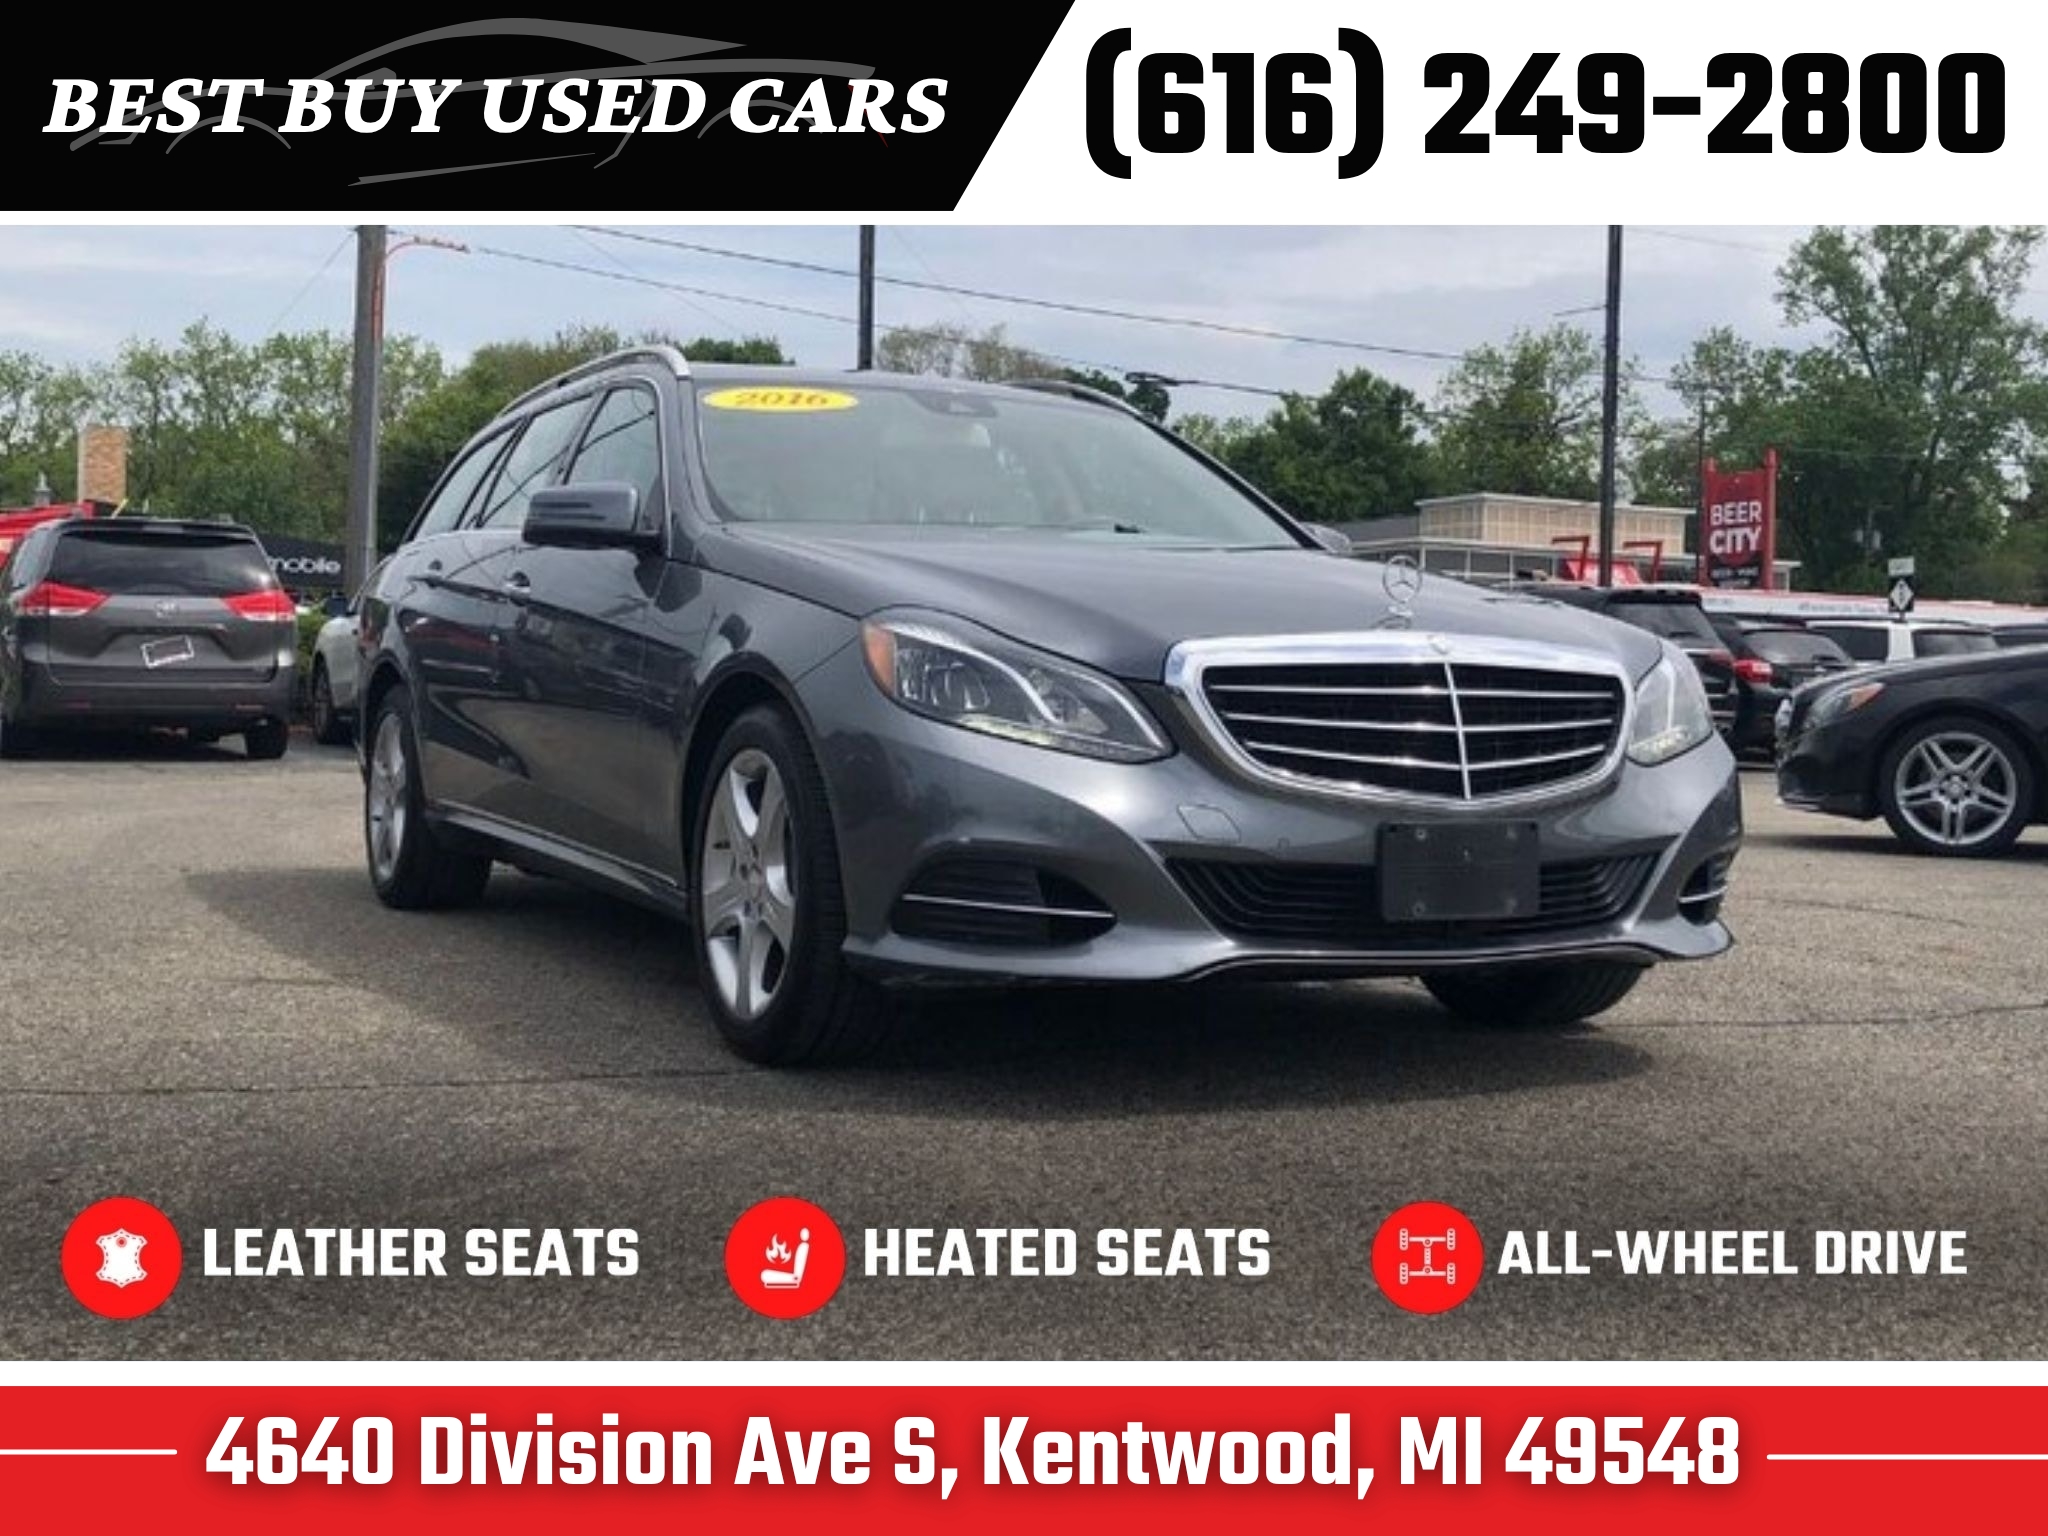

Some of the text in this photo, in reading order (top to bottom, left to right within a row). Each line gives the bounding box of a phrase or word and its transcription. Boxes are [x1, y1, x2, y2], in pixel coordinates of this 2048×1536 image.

[734, 391, 829, 407] 2016
[1710, 501, 1762, 526] BEER
[1710, 527, 1762, 554] CITY
